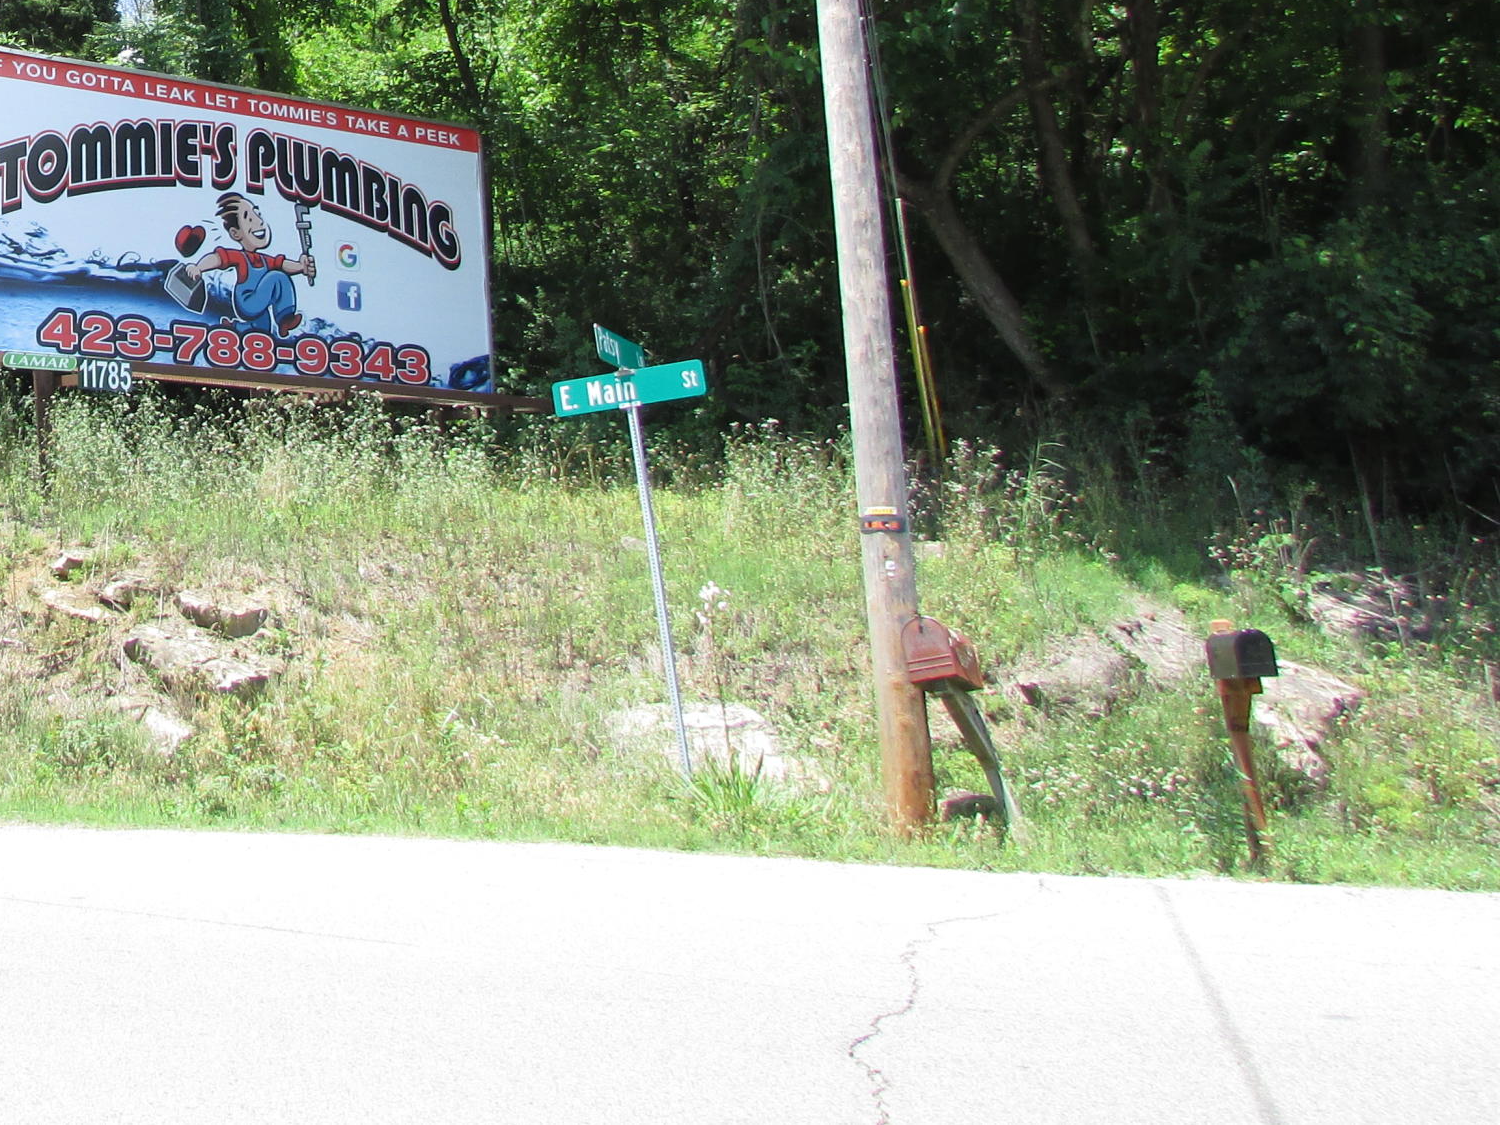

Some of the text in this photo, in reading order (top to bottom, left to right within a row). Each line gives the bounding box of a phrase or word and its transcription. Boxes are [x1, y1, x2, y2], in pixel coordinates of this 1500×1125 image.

[12, 60, 56, 81] YOU
[65, 70, 135, 93] GOTTA
[144, 82, 196, 103] LEAK
[204, 92, 239, 110] LET
[247, 98, 337, 126] TOMMIE'S
[345, 114, 390, 134] TAKE
[397, 125, 409, 138] A
[415, 126, 461, 147] PEEK
[245, 127, 461, 270] PLUMBING
[8, 354, 70, 369] LAMAR
[38, 308, 430, 385] 423-788-9343
[598, 327, 620, 365] Patsy
[79, 358, 132, 390] 11785
[559, 370, 699, 411] E. Main St
